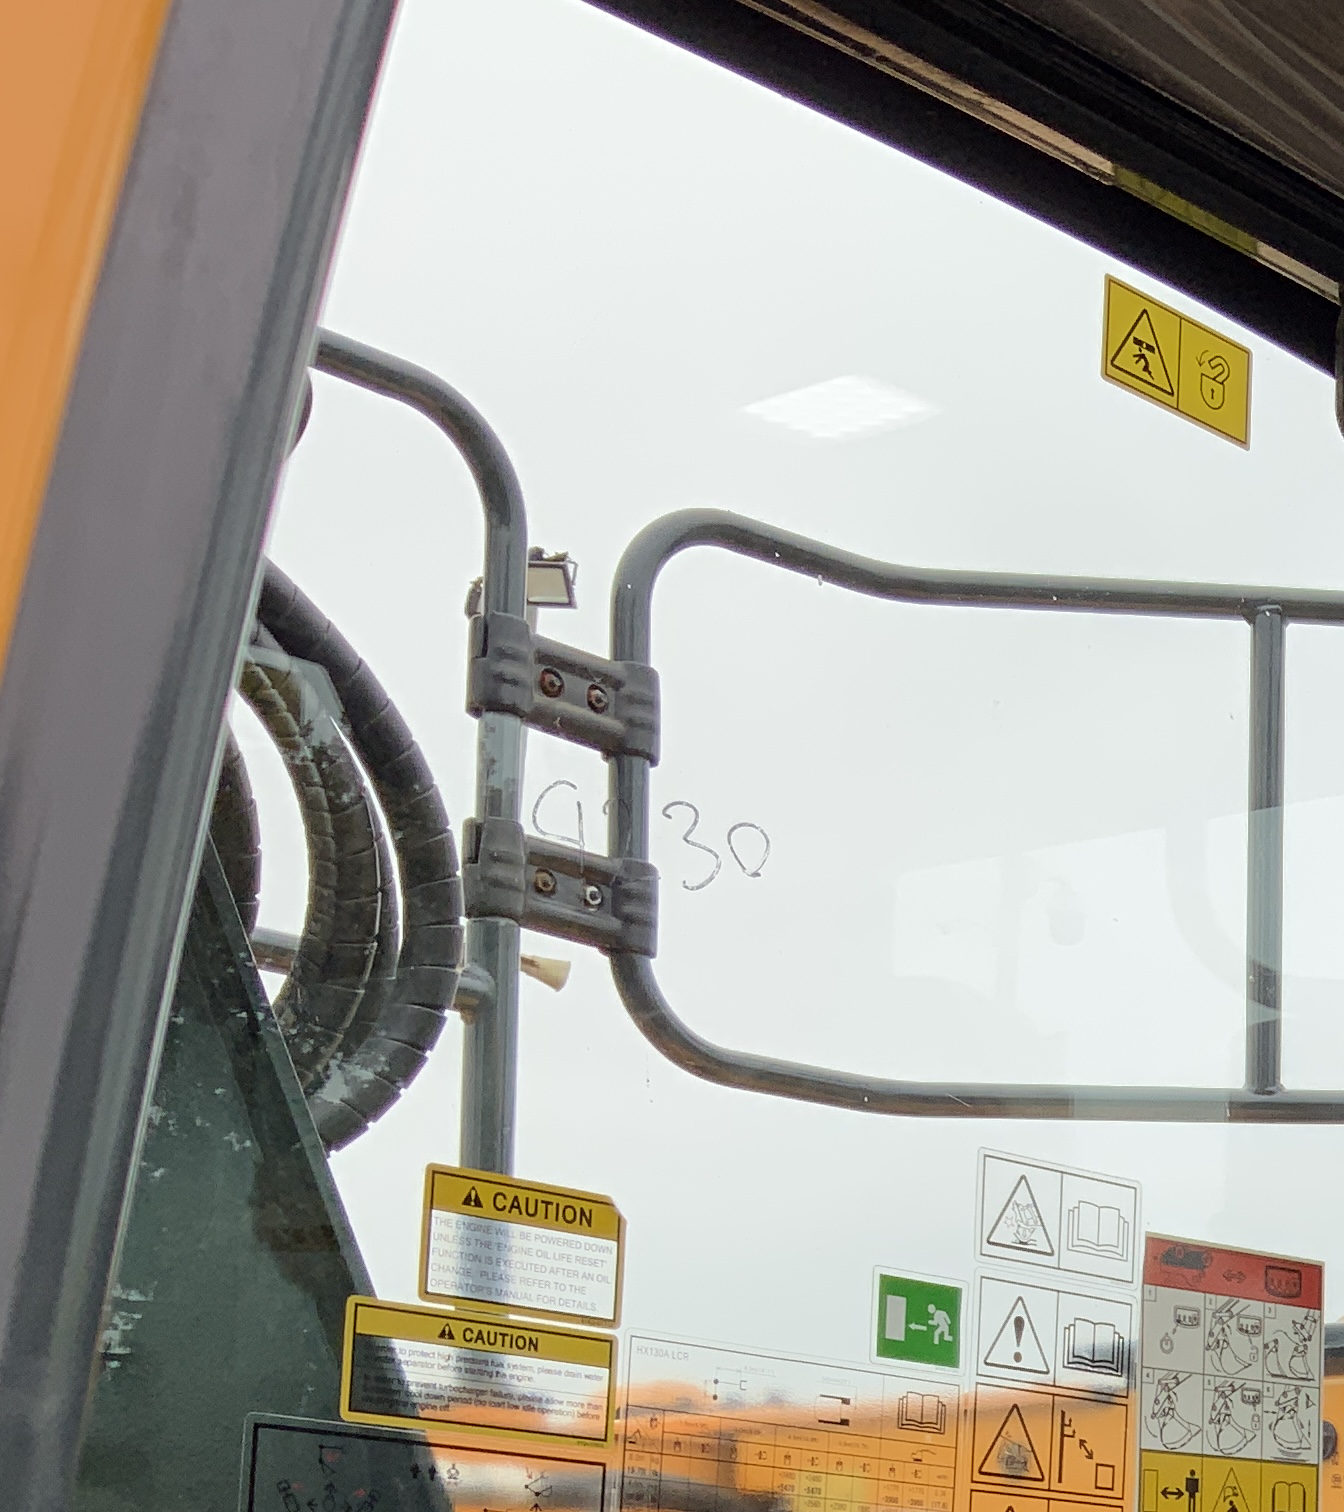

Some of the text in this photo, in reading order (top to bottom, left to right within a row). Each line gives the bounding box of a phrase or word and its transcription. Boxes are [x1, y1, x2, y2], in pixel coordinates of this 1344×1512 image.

[492, 1191, 593, 1228] CAUTION
[433, 1232, 471, 1247] UNLESS
[475, 1238, 492, 1251] THE
[535, 1249, 551, 1260] OIL
[553, 1252, 573, 1263] LIFE
[434, 1217, 613, 1256] THE ENGINE WILL BE POWERED DOWN
[432, 1247, 612, 1284] FUNCTION IS EXECUTED AFTER AN OIL
[430, 1278, 492, 1296] OPERATOR'S
[495, 1288, 534, 1303] MANUAL
[536, 1294, 556, 1305] FOR
[480, 1270, 518, 1284] PLEASE
[520, 1276, 551, 1289] REFER
[553, 1281, 566, 1292] TO
[568, 1284, 587, 1295] THE
[462, 1326, 540, 1353] CAUTION
[636, 1345, 690, 1361] HX130A LCR
[408, 1349, 435, 1360] protect
[437, 1351, 453, 1362] high
[537, 1366, 562, 1376] please
[564, 1369, 582, 1379] drain
[584, 1373, 604, 1382] water
[437, 1362, 463, 1373] before
[424, 1392, 446, 1401] down
[447, 1395, 472, 1405] period
[576, 1410, 601, 1421] before
[566, 1399, 585, 1408] more
[587, 1402, 603, 1411] than
